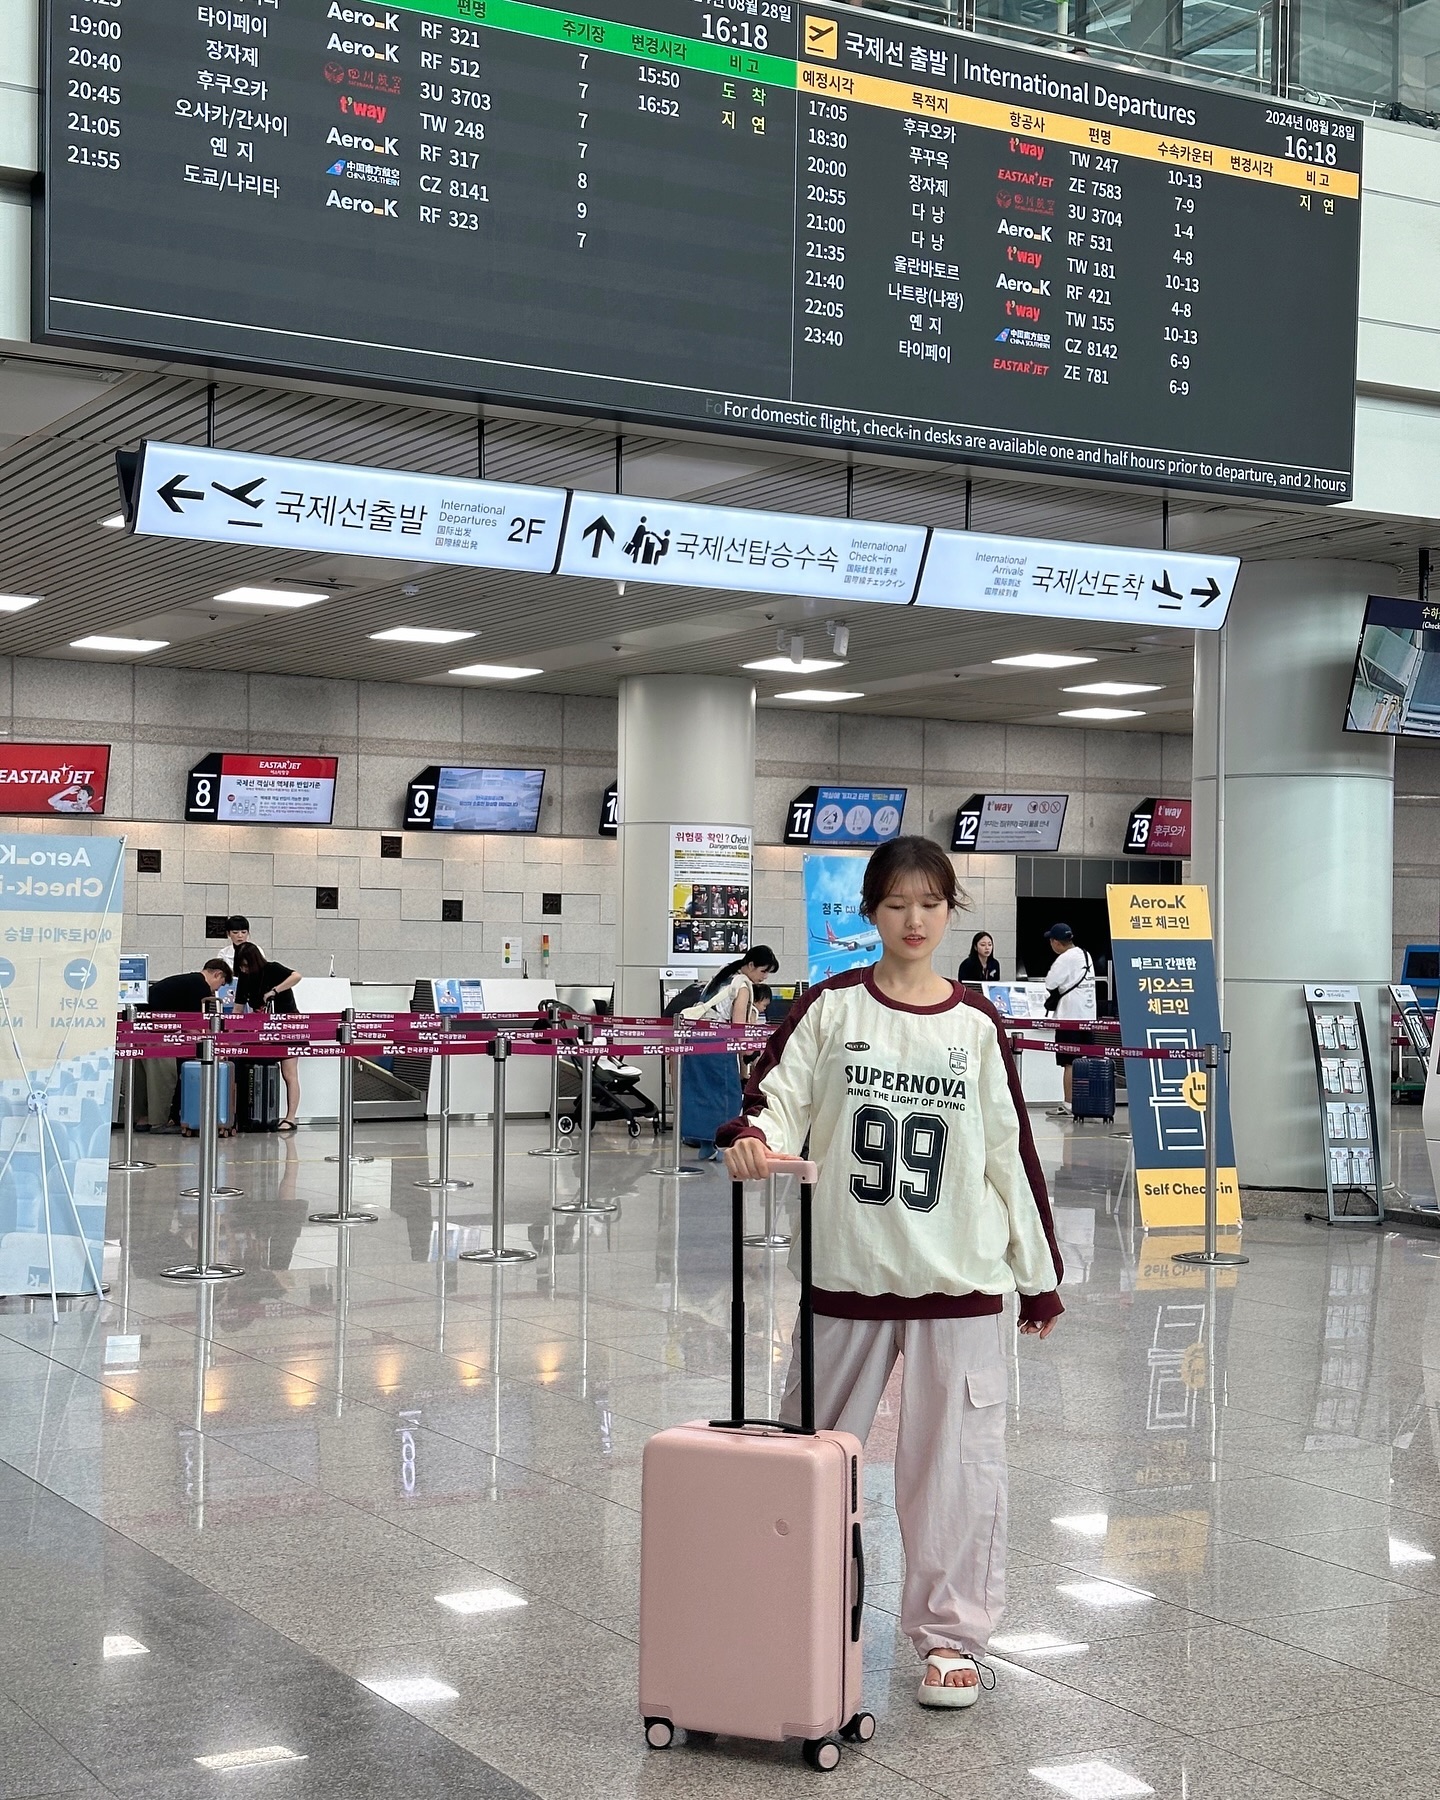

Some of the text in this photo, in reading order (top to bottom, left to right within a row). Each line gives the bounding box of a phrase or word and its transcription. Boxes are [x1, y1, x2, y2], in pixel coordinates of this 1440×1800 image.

[70, 14, 122, 39] 19:00
[198, 7, 266, 37] 타이페이
[563, 19, 605, 43] 주기장
[450, 27, 479, 48] 321
[701, 14, 769, 51] 16:18
[207, 39, 259, 67] 장자제
[632, 34, 686, 60] 변경시각
[69, 47, 121, 72] 20:40
[450, 57, 480, 78] 512
[579, 53, 588, 69] 7
[197, 70, 268, 100] 후쿠오카
[639, 66, 679, 88] 15:50
[803, 71, 854, 94] 예정시각
[845, 32, 1195, 125] 국제선 출발 International Departures
[69, 79, 120, 104] 20:45
[451, 89, 490, 110] 3703
[639, 95, 679, 117] 16:52
[809, 101, 847, 121] 17:05
[912, 92, 947, 113] 목적지
[68, 113, 121, 137] 21:05
[175, 99, 288, 136] 오사카/간사이
[1010, 112, 1045, 132] 항공사
[455, 120, 484, 139] 248
[809, 129, 846, 148] 18:30
[903, 118, 956, 143] 후쿠오카
[68, 146, 121, 169] 21:55
[449, 150, 479, 169] 317
[910, 147, 949, 169] 푸꾸옥
[1158, 142, 1212, 165] 수속카운터
[1285, 136, 1336, 165] 16:18
[808, 157, 846, 177] 20:00
[1096, 156, 1118, 173] 247
[184, 164, 279, 198] 도쿄/나리타
[450, 181, 489, 201] 8141
[909, 175, 948, 197] 장자제
[1092, 182, 1121, 200] 7583
[807, 185, 845, 205] 20:55
[449, 211, 478, 230] 323
[807, 214, 845, 233] 21:00
[1092, 209, 1122, 226] 3704
[806, 242, 844, 261] 21:35
[1090, 235, 1112, 252] 531
[894, 256, 959, 280] 울란바토르
[1093, 263, 1115, 279] 181
[806, 270, 844, 289] 21:40
[889, 283, 963, 312] 나트랑(냐짱)
[1088, 289, 1111, 305] 421
[805, 299, 843, 318] 22:05
[1092, 316, 1114, 331] 155
[805, 327, 842, 346] 23:40
[899, 340, 950, 363] 타이페이
[1088, 342, 1117, 359] 8142
[1087, 368, 1108, 384] 781
[725, 401, 748, 417] For
[751, 404, 816, 427] domestic
[820, 412, 861, 436] flight,
[864, 420, 920, 440] check-in
[925, 427, 962, 445] desks
[965, 436, 986, 448] are
[989, 438, 1047, 456] available
[1050, 447, 1074, 459] one
[1077, 448, 1100, 462] and
[1105, 449, 1128, 465] half
[1131, 453, 1165, 470] hours
[1168, 459, 1199, 476] prior
[1200, 460, 1212, 475] to
[1215, 463, 1277, 487] departure,
[1280, 473, 1301, 486] and
[1304, 474, 1311, 487] 2
[1314, 476, 1346, 491] hours
[276, 492, 427, 535] 국제선출발
[441, 500, 505, 515] International
[440, 512, 496, 526] Departures
[437, 526, 471, 537] 国际出发
[508, 518, 545, 543] 2F
[676, 533, 838, 572] 국제선탑승수속
[852, 539, 906, 552] International
[849, 551, 891, 563] Check-in
[976, 553, 1027, 565] International
[992, 565, 1023, 576] Arrivals
[994, 578, 1021, 587] 国际到达
[1032, 567, 1144, 600] 국제선도착
[0, 770, 94, 784] EASTAR JET
[196, 780, 210, 806] 8
[414, 791, 428, 816] 9
[794, 809, 811, 832] 11
[958, 816, 979, 840] 12
[1154, 825, 1185, 836] 후쿠오카
[676, 832, 702, 842] 위험품
[1133, 820, 1149, 842] 13
[1130, 916, 1189, 929] 셀프 체크인
[1131, 957, 1196, 970] 빠르고 간편한
[1139, 977, 1194, 994] 키오스크
[1148, 998, 1189, 1015] 체크인
[845, 1065, 966, 1099] SUPERNOVA
[873, 1091, 888, 1100] THE
[892, 1096, 919, 1105] LIGHT
[937, 1101, 965, 1111] DYING
[850, 1104, 948, 1213] 99
[1145, 1183, 1232, 1195] Self Chec-in
